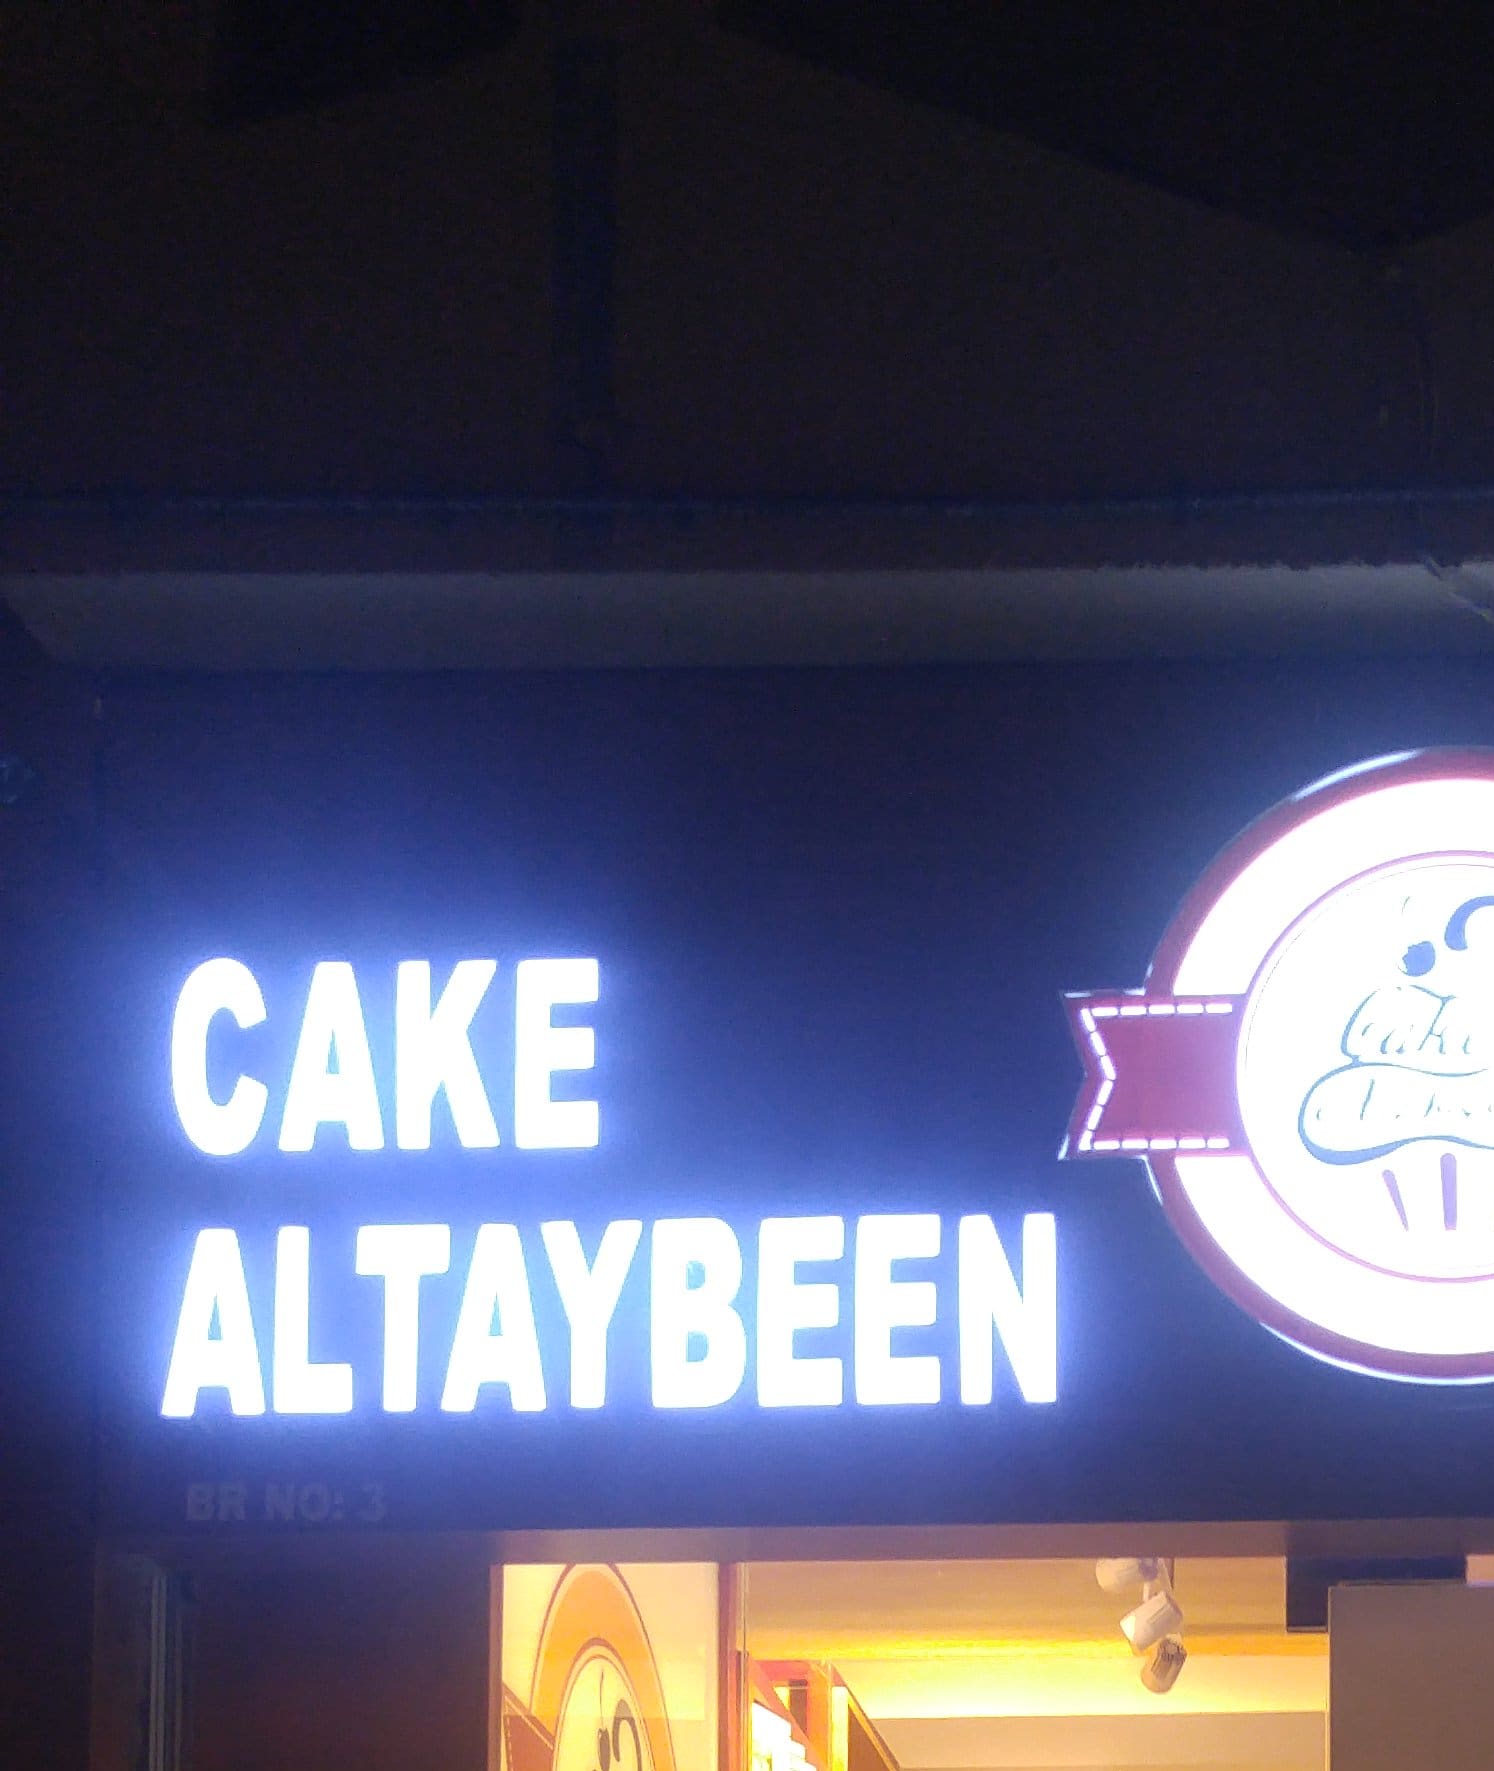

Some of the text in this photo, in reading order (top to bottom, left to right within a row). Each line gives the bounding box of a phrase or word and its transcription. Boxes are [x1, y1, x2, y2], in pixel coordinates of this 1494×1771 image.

[171, 957, 599, 1155] CAKE
[161, 1212, 1057, 1417] ALTAYBEEN
[186, 1481, 248, 1521] BR
[360, 1480, 386, 1522] 3
